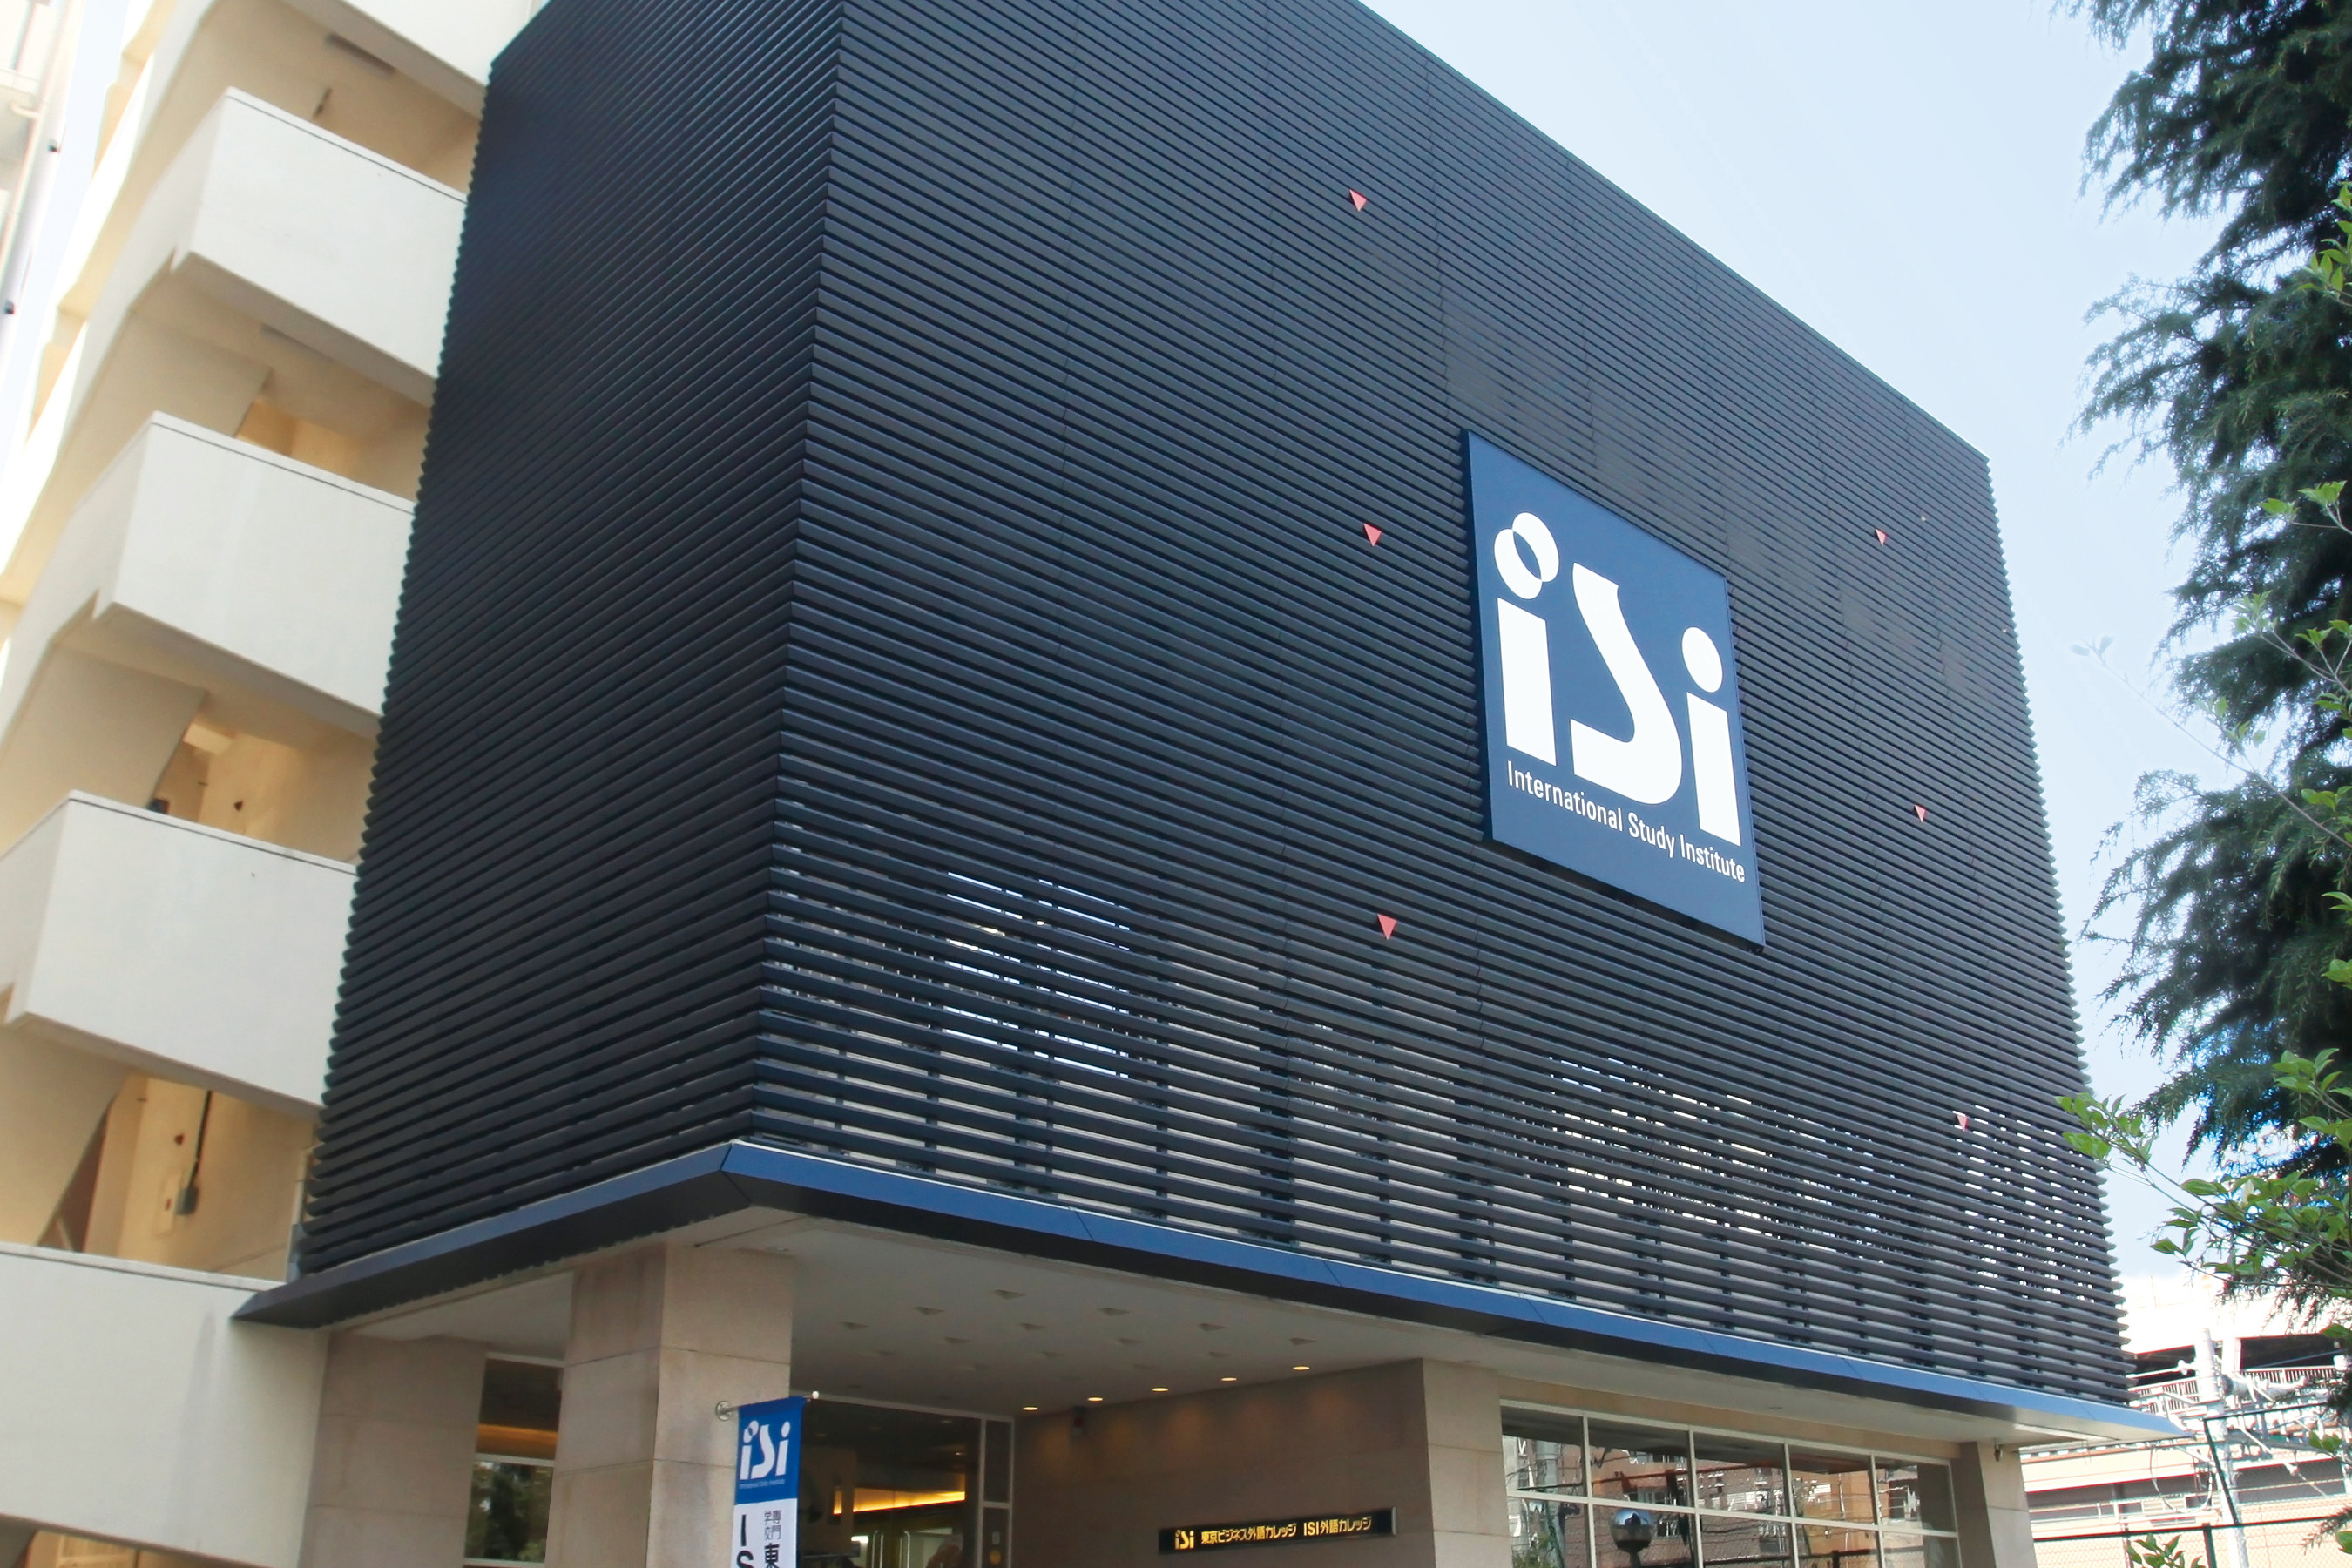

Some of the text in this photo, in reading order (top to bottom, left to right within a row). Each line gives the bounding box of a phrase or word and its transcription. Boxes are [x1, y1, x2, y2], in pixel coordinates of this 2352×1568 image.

[1507, 760, 1747, 883] International Study Institute
